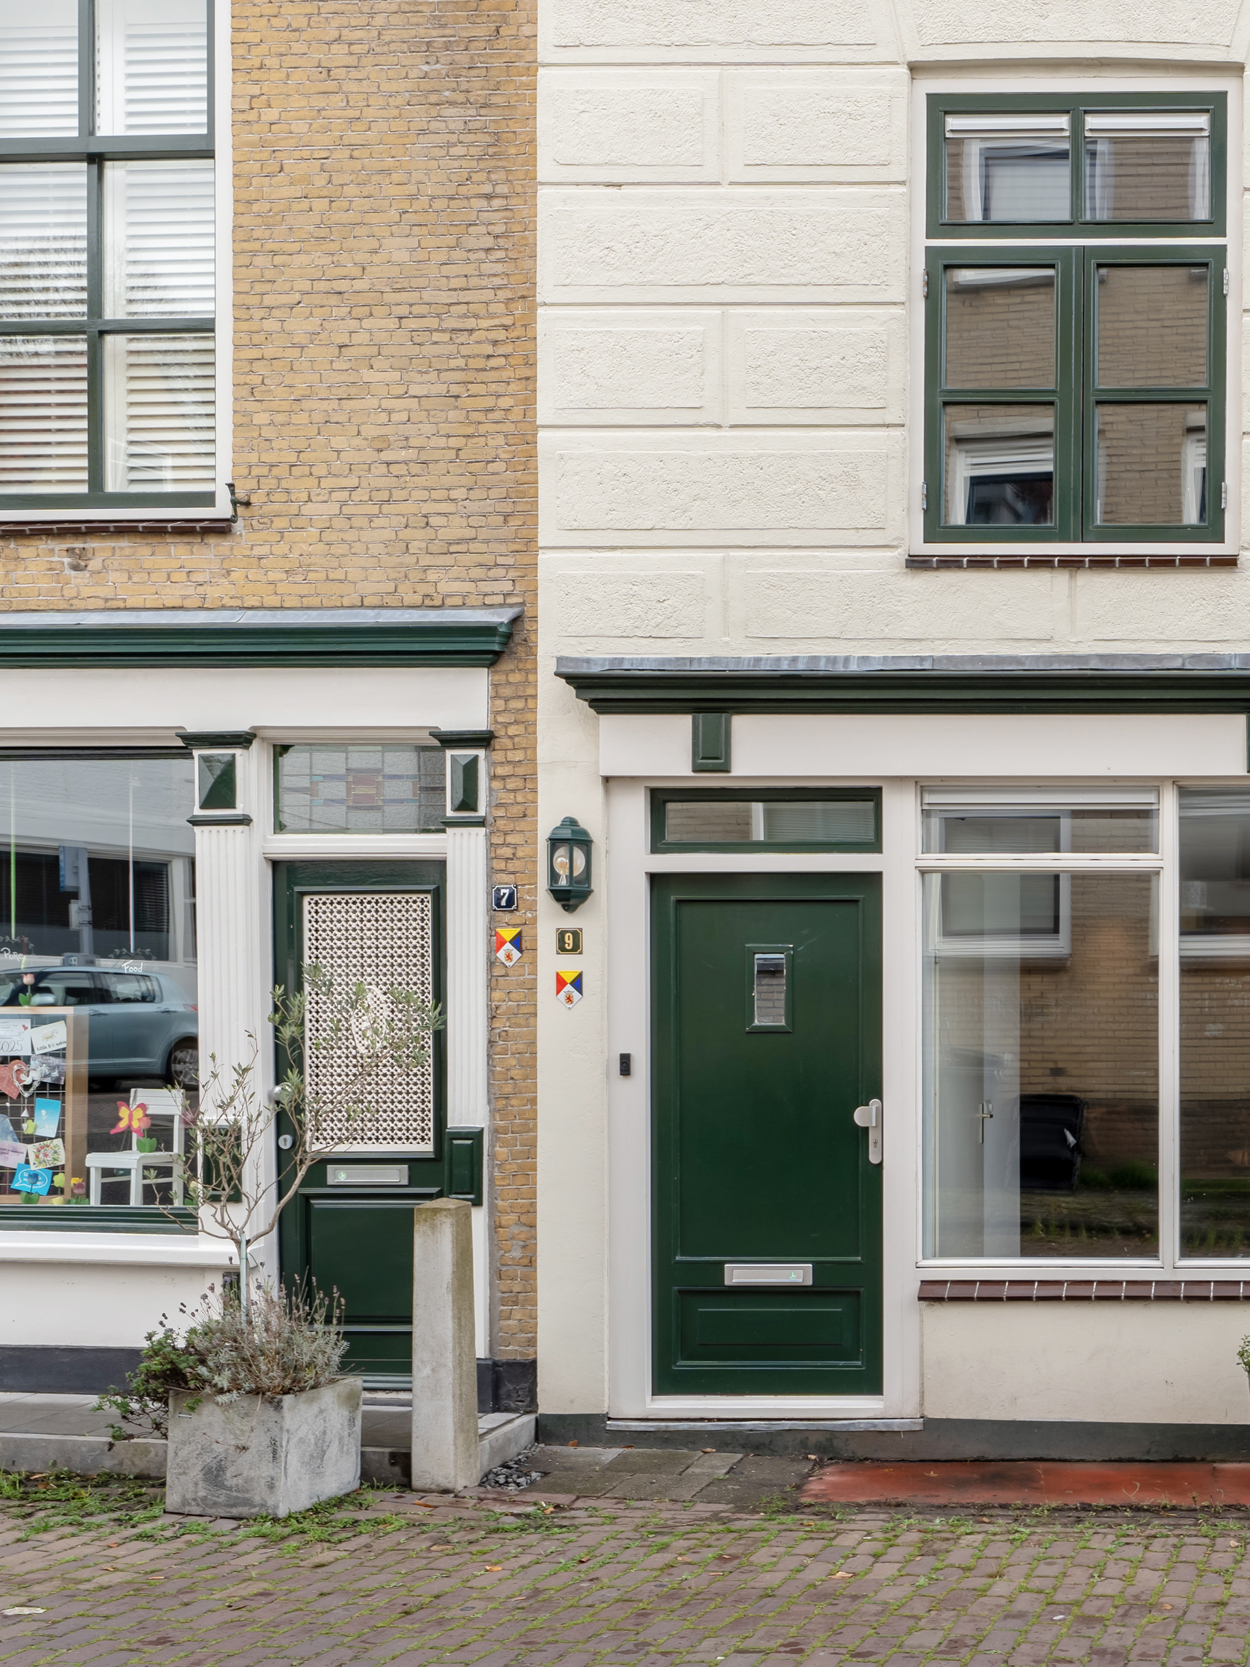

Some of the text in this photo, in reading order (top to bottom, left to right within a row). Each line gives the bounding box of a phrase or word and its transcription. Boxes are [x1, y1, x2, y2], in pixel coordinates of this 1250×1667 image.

[500, 888, 510, 906] 7
[564, 932, 574, 950] 9
[121, 959, 143, 974] Food
[0, 1039, 23, 1053] 025
